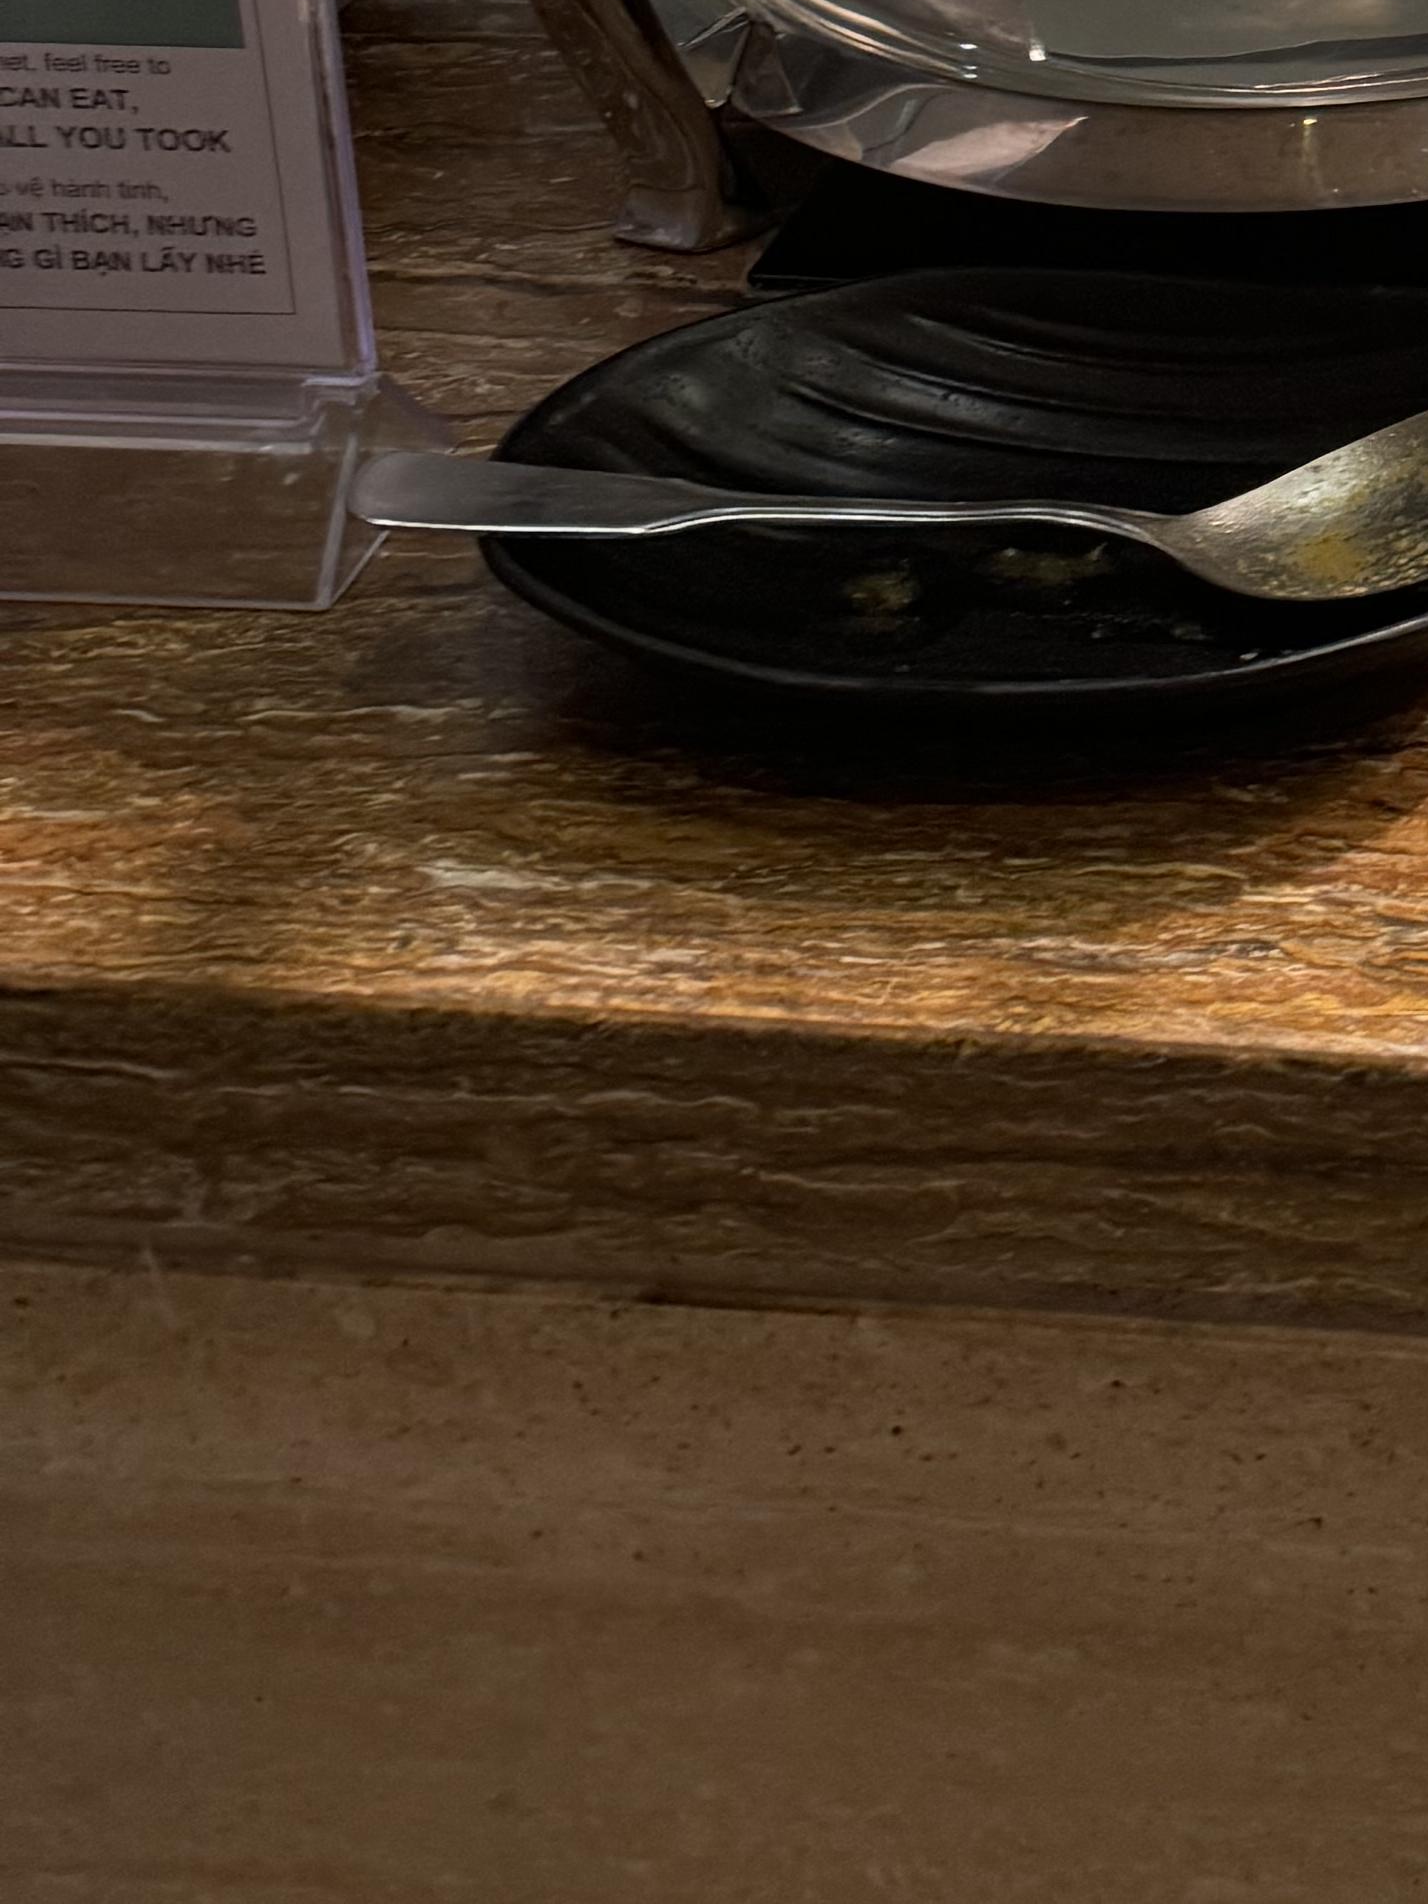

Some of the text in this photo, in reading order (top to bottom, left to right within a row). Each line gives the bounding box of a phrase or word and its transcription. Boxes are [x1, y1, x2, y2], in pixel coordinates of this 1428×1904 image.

[44, 52, 88, 73] feel
[93, 53, 140, 75] free
[146, 57, 172, 75] to
[69, 87, 139, 115] EAT,
[55, 125, 126, 150] YOU
[133, 127, 232, 154] TOOK
